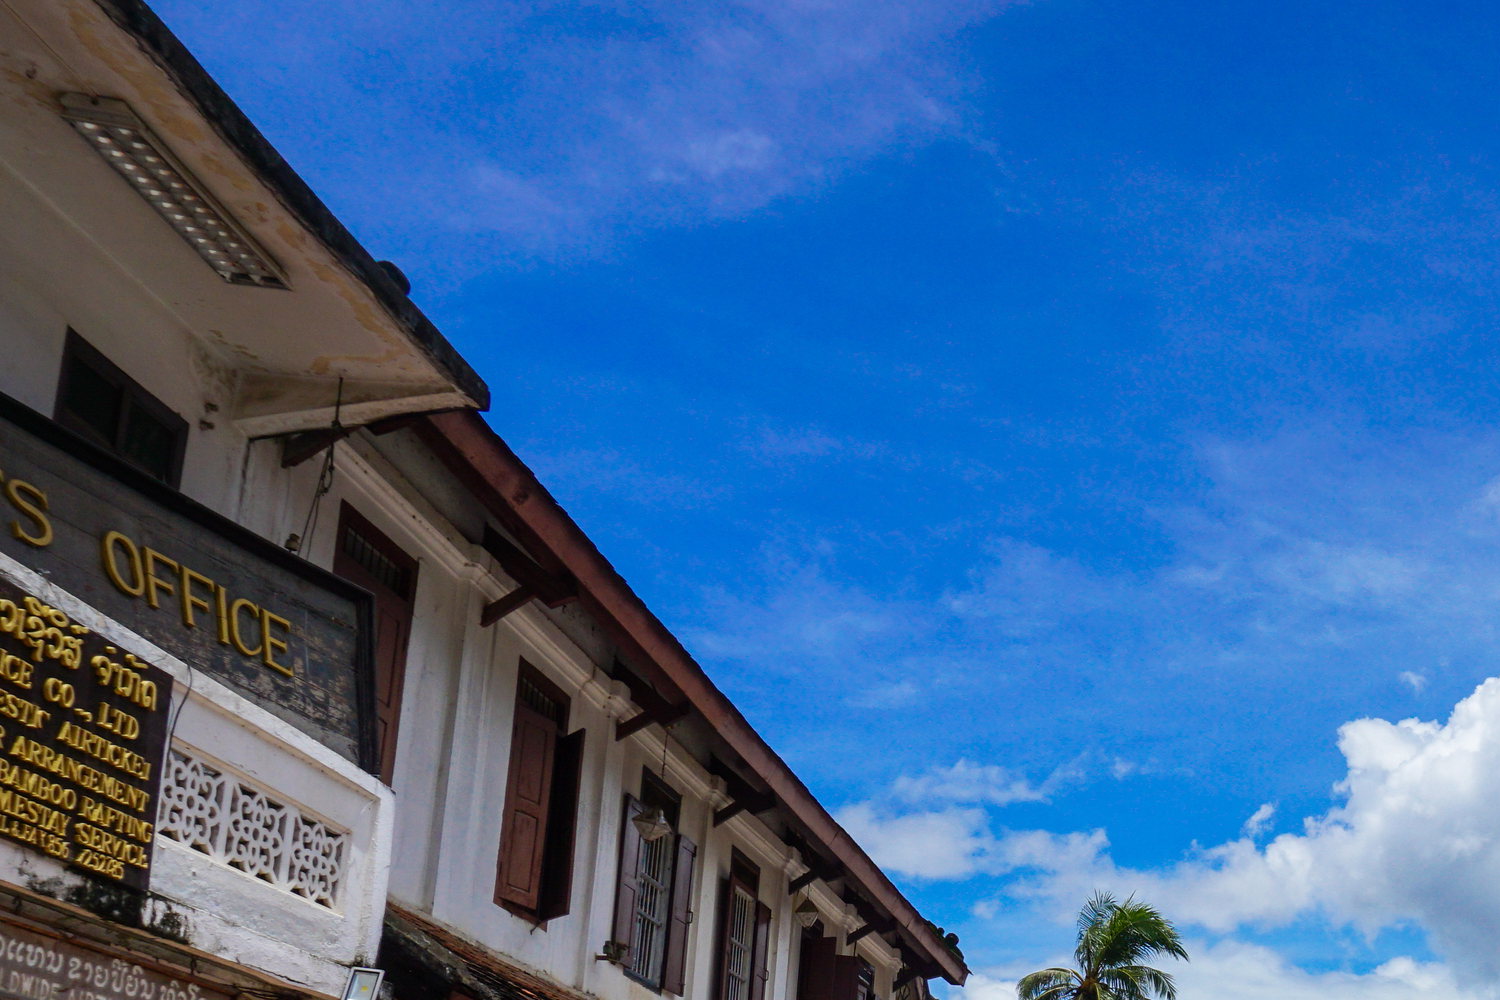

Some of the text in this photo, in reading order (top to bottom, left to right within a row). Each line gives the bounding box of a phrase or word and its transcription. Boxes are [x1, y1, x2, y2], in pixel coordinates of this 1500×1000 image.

[104, 530, 293, 677] OFFICE
[96, 702, 140, 740] LTD
[9, 735, 150, 812] ARRANGEMENT
[77, 795, 153, 843] RAFTING
[74, 822, 149, 868] SERVICE
